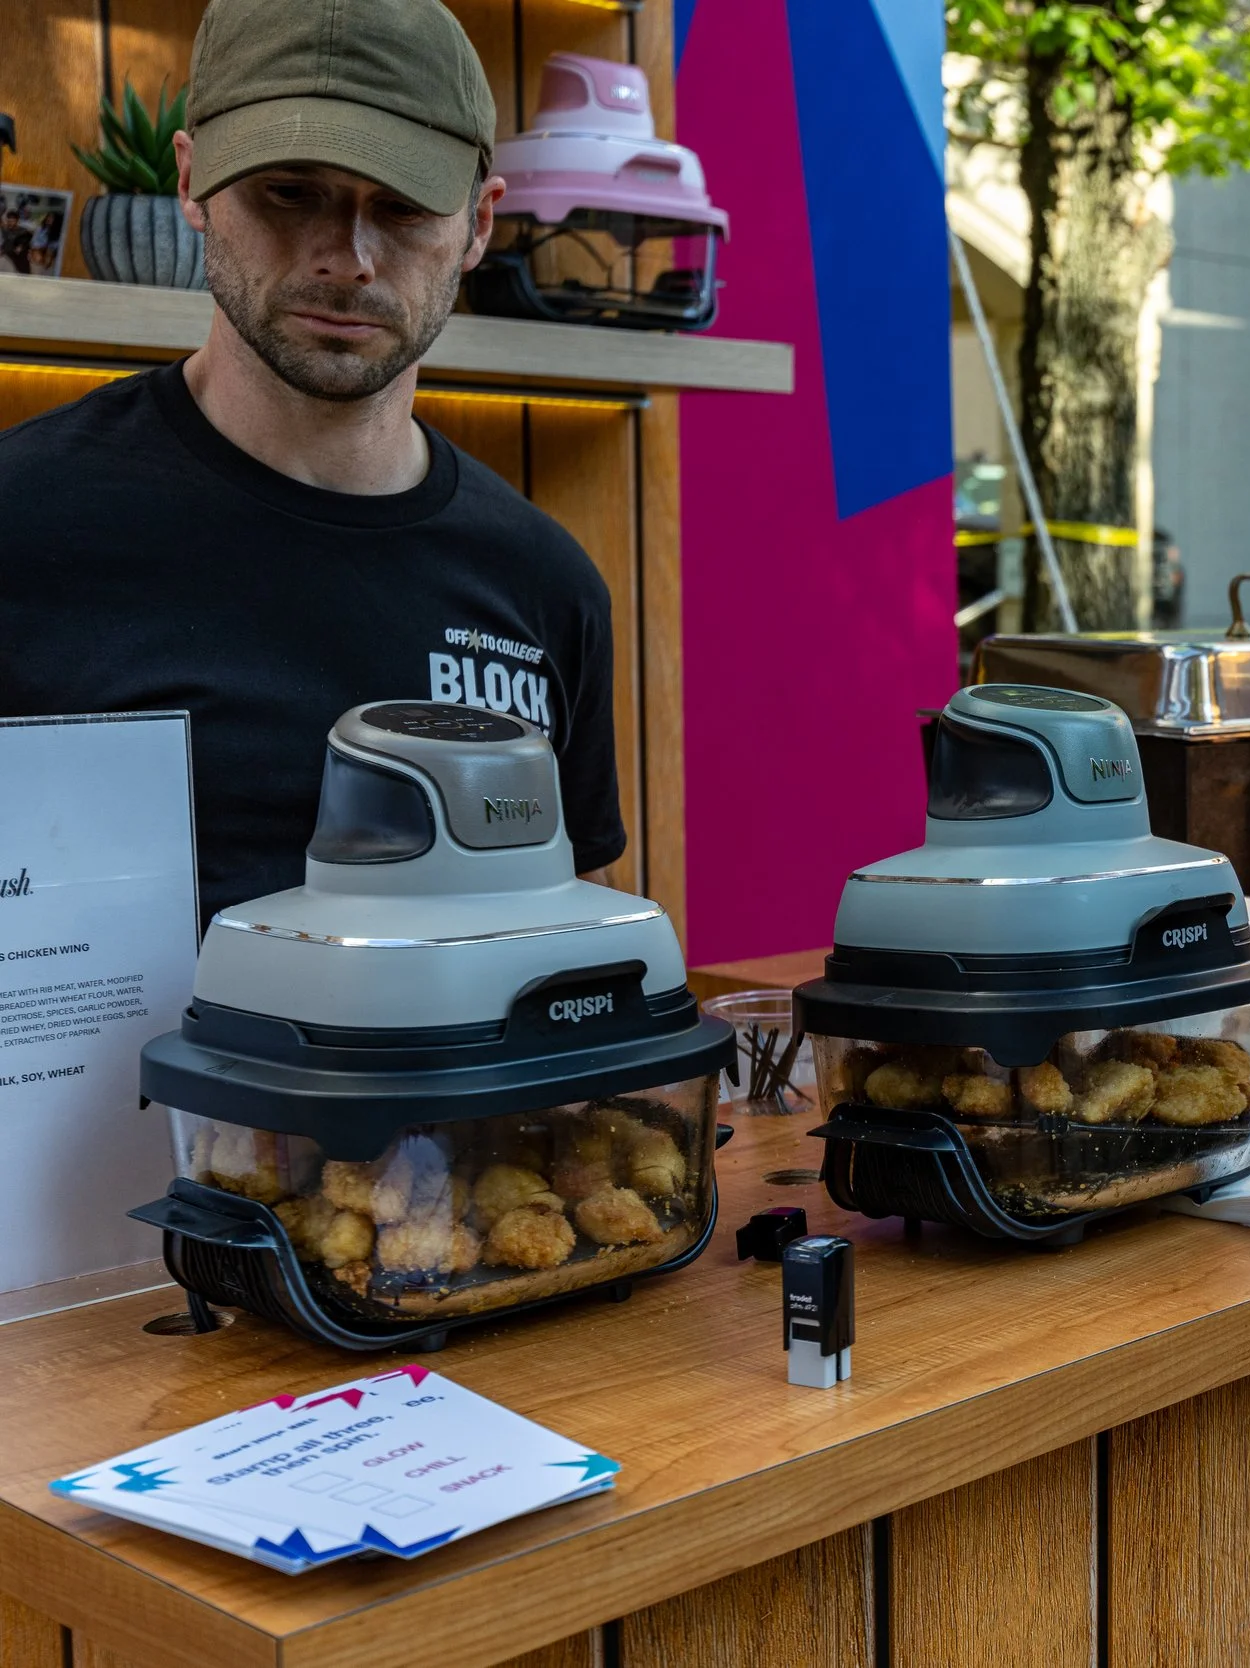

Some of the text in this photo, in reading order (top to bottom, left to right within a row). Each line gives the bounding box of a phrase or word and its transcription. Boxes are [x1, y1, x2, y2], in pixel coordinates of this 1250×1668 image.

[445, 627, 545, 665] OFF TO COLLEGE
[429, 652, 551, 728] BLOCK
[1089, 757, 1133, 783] NINJA
[483, 797, 543, 825] NINJA
[7, 946, 58, 961] CHICKEN
[60, 943, 91, 955] WING
[18, 987, 39, 997] WITH
[40, 985, 53, 994] RIB
[54, 982, 77, 992] MEAT,
[77, 979, 106, 990] WATER,
[107, 974, 144, 985] MODIFIED
[38, 997, 59, 1006] WITH
[60, 993, 87, 1003] WHEAT
[88, 988, 116, 1000] FLOUR,
[116, 985, 144, 996] WATER,
[1, 997, 143, 1024] DEXTROSE, SPICES, GARLIC POWDER,
[21, 1023, 47, 1033] WHEY,
[48, 1019, 72, 1030] DRIED
[72, 1015, 102, 1026] WHOLE
[102, 1011, 126, 1022] EGGS,
[127, 1008, 149, 1018] SPICE
[4, 1027, 101, 1048] EXTRACTIVES OF PAPRIKA
[21, 1071, 46, 1083] SOY,
[48, 1065, 86, 1078] WHEAT
[206, 1450, 292, 1486] Stamp
[293, 1437, 325, 1454] all
[321, 1414, 395, 1441] three,
[260, 1453, 321, 1478] then
[321, 1431, 381, 1455] spin.
[361, 1440, 426, 1468] GLOW
[403, 1454, 468, 1479] CHILL
[439, 1463, 514, 1494] SNACK
